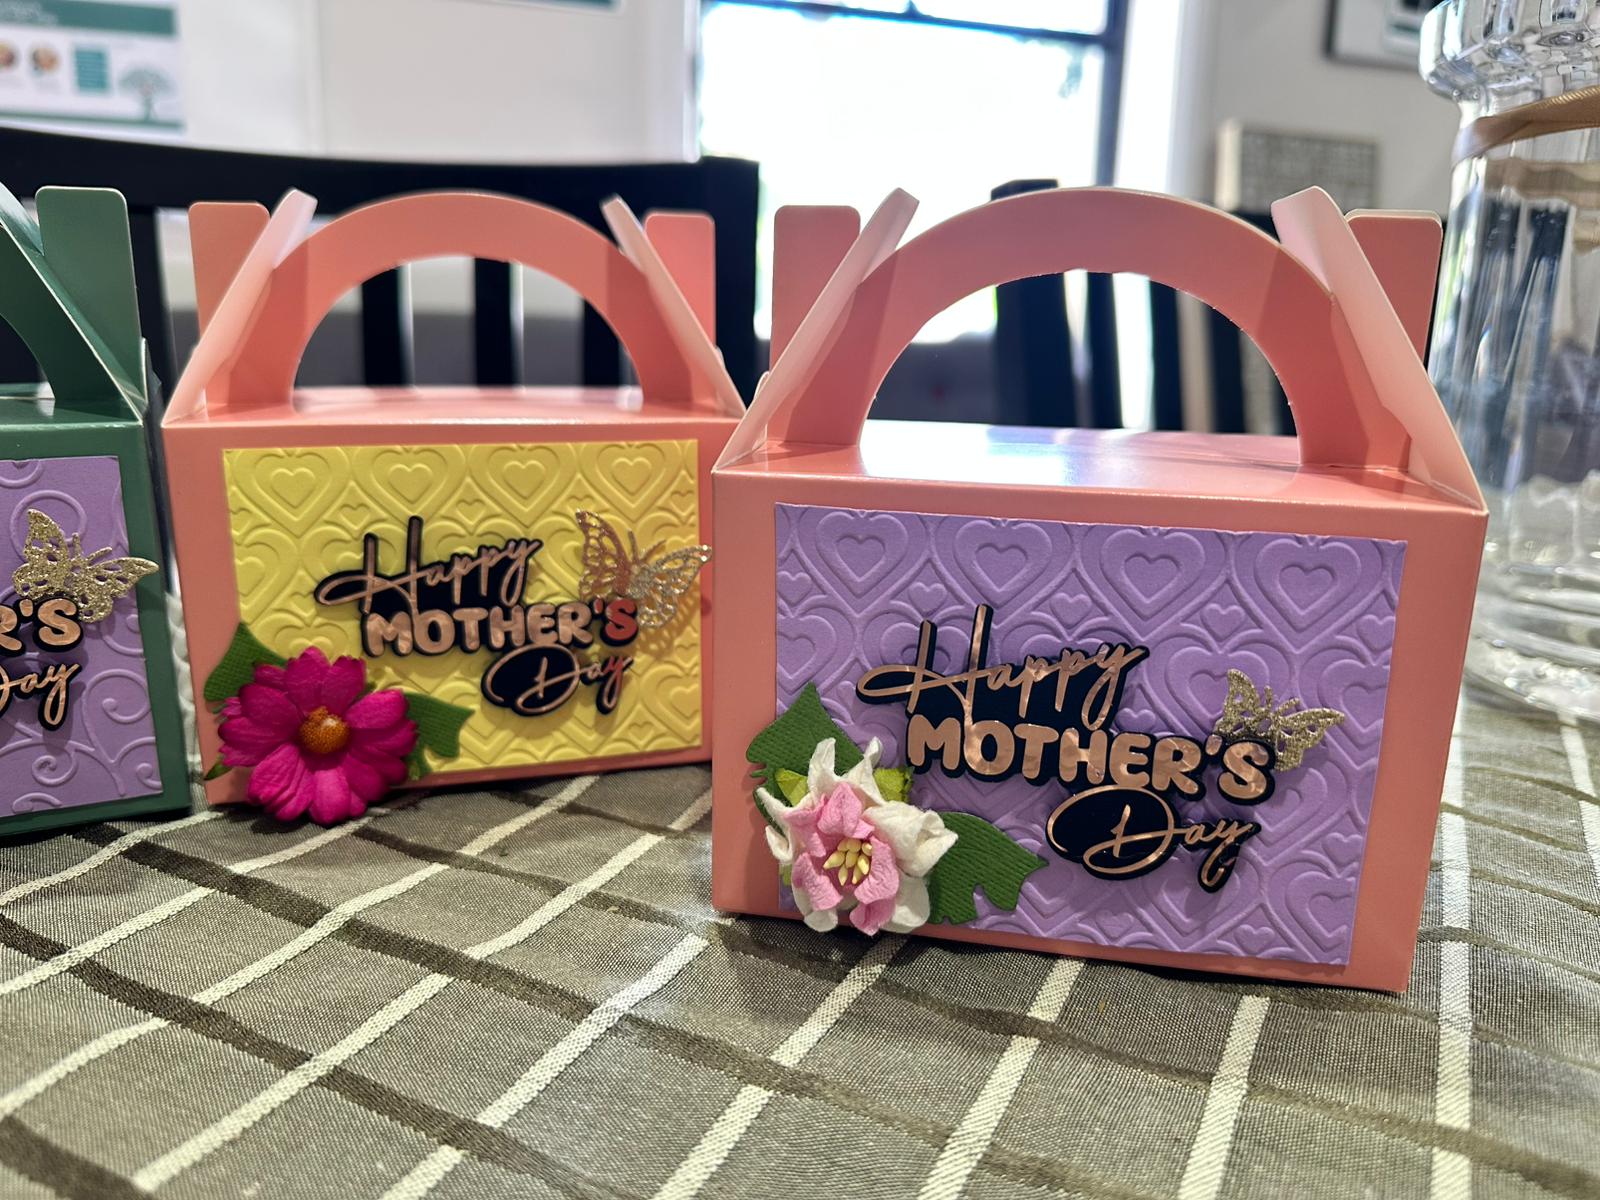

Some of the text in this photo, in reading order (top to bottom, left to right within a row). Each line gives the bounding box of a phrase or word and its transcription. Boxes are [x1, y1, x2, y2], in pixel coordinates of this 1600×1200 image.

[315, 515, 544, 616] Happy
[361, 598, 640, 657] MOTHER'S
[856, 603, 1149, 731] Happy
[0, 662, 82, 731] ay
[481, 642, 634, 716] Day
[907, 714, 1275, 801] MOTHER'S
[1046, 783, 1261, 889] Day
